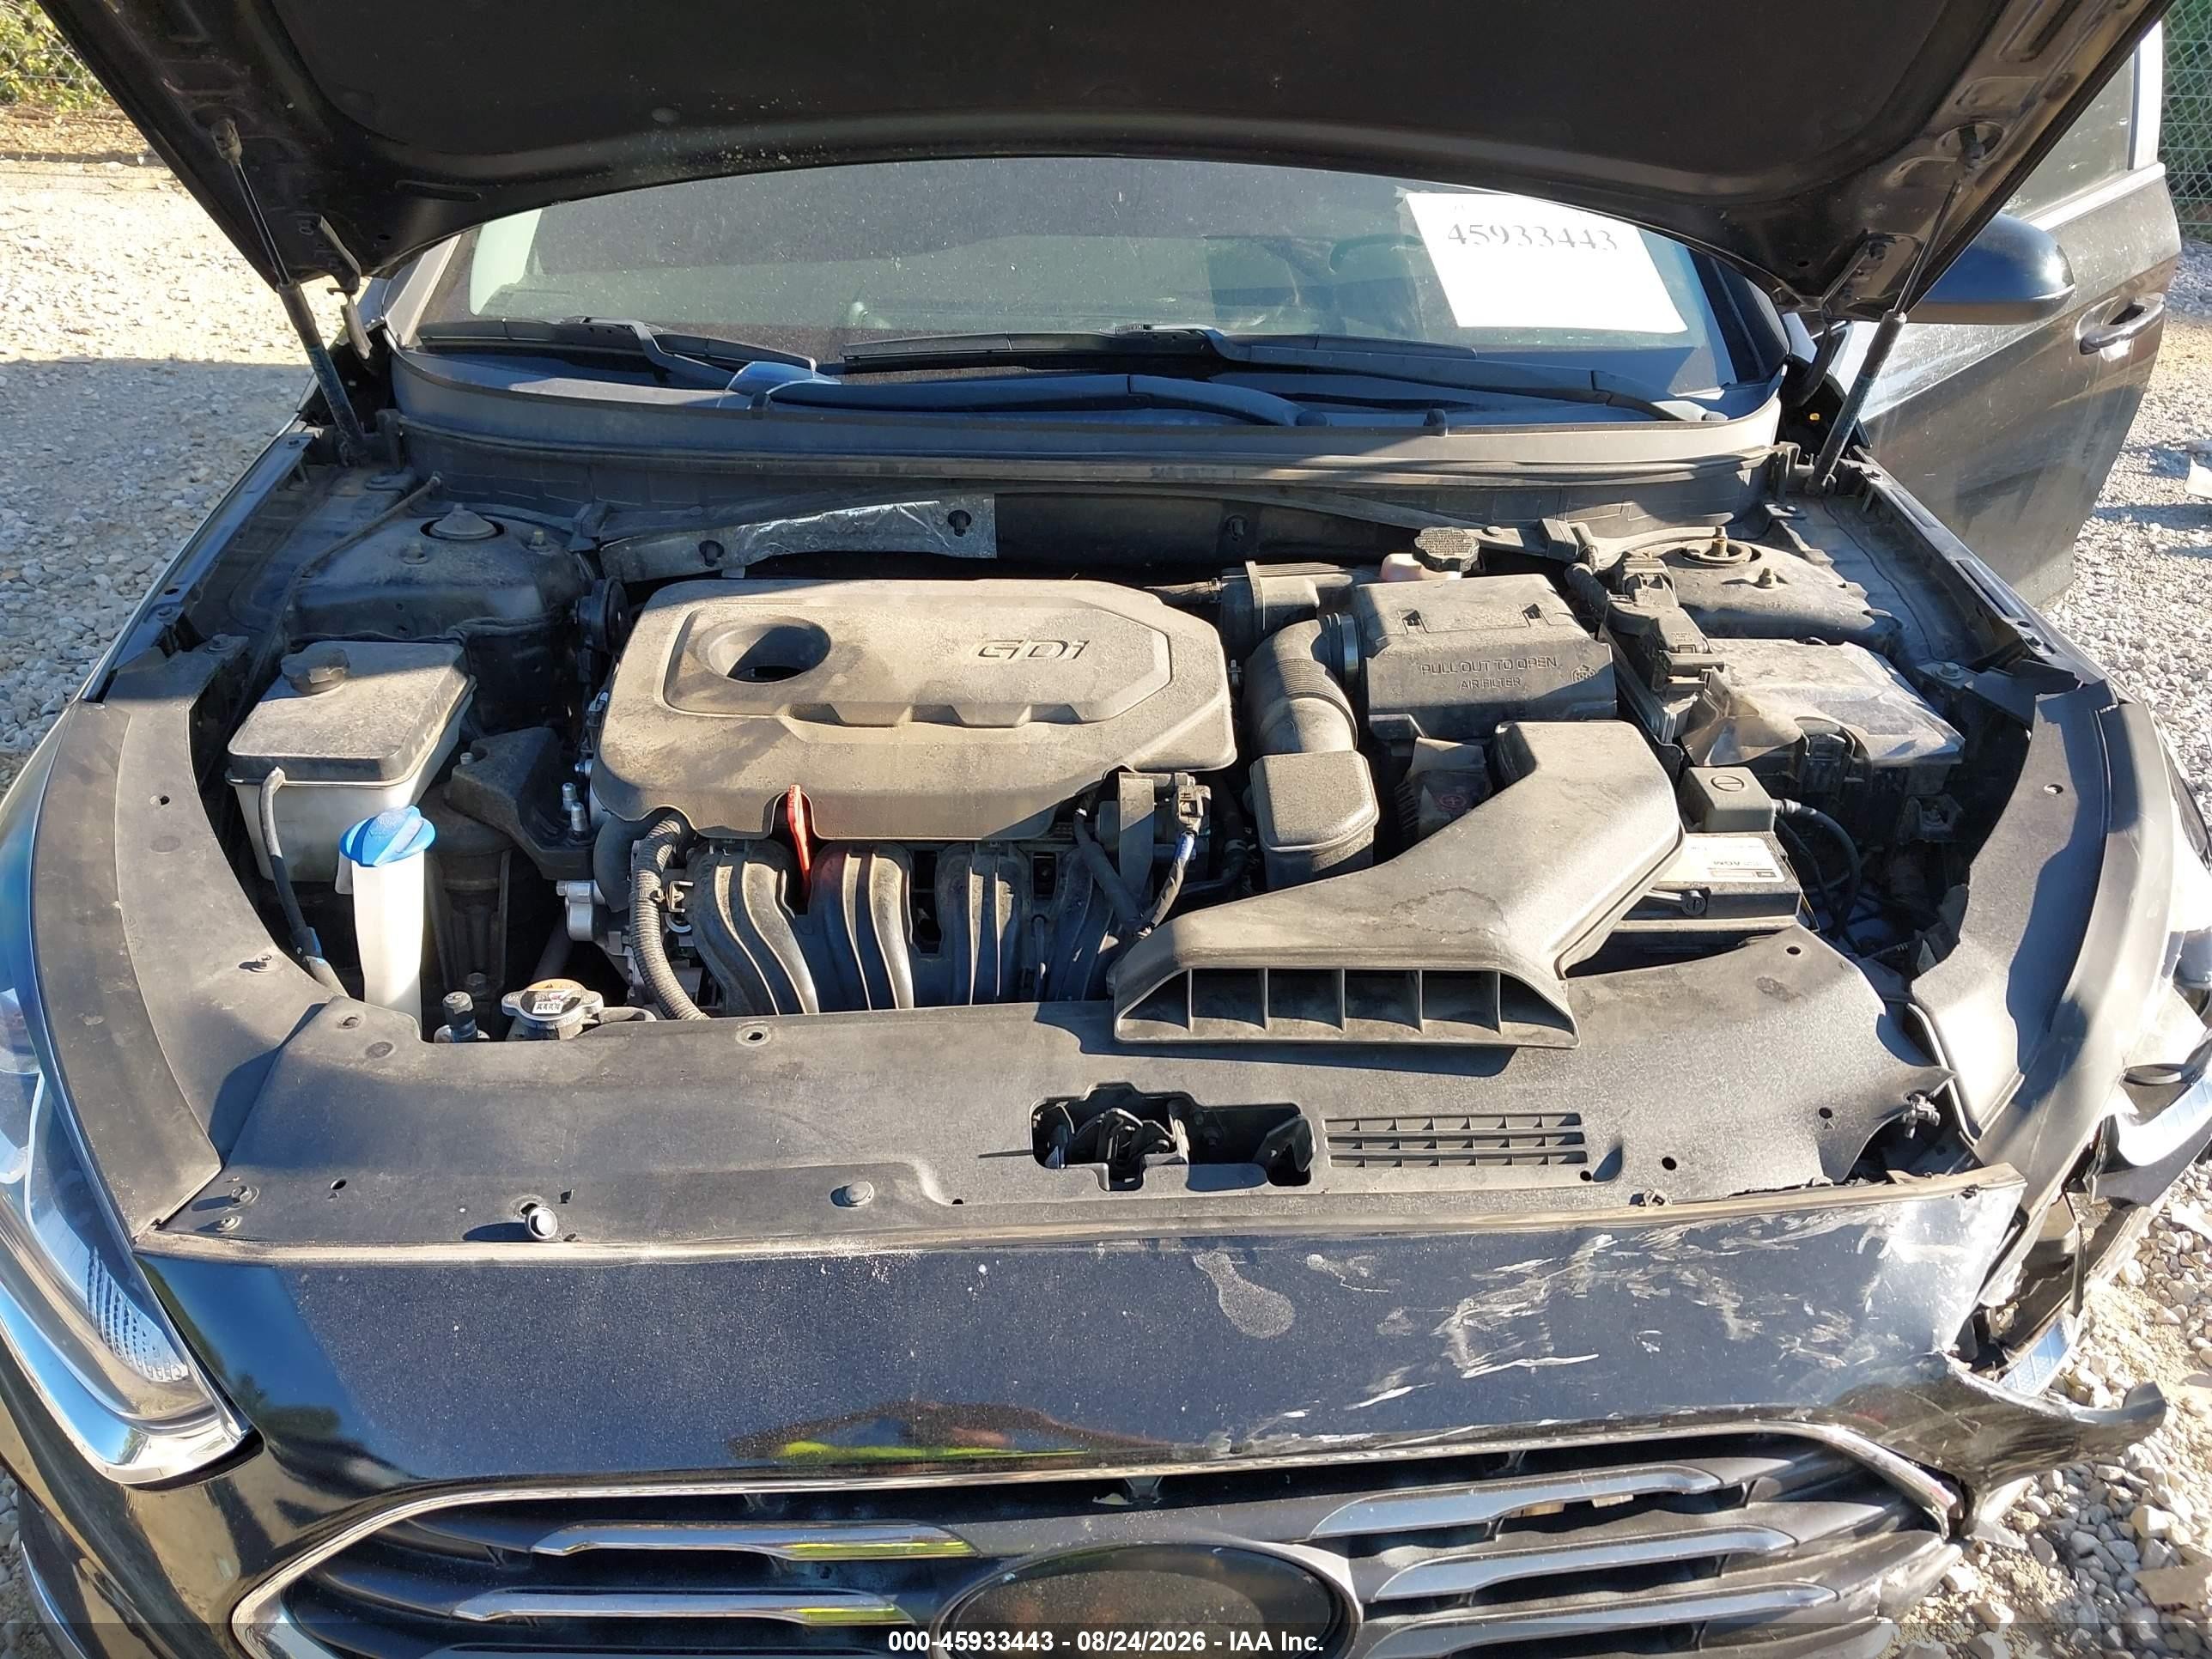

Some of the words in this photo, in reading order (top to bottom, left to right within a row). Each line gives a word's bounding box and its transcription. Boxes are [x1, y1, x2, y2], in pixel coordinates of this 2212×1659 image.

[1447, 222, 1618, 252] 45933443
[1421, 662, 1458, 675] PULL
[1461, 659, 1490, 672] OUT
[1493, 658, 1514, 671] TO
[1516, 656, 1558, 670] OPEN
[1460, 679, 1480, 690] AIR
[1482, 677, 1522, 689] FILTER
